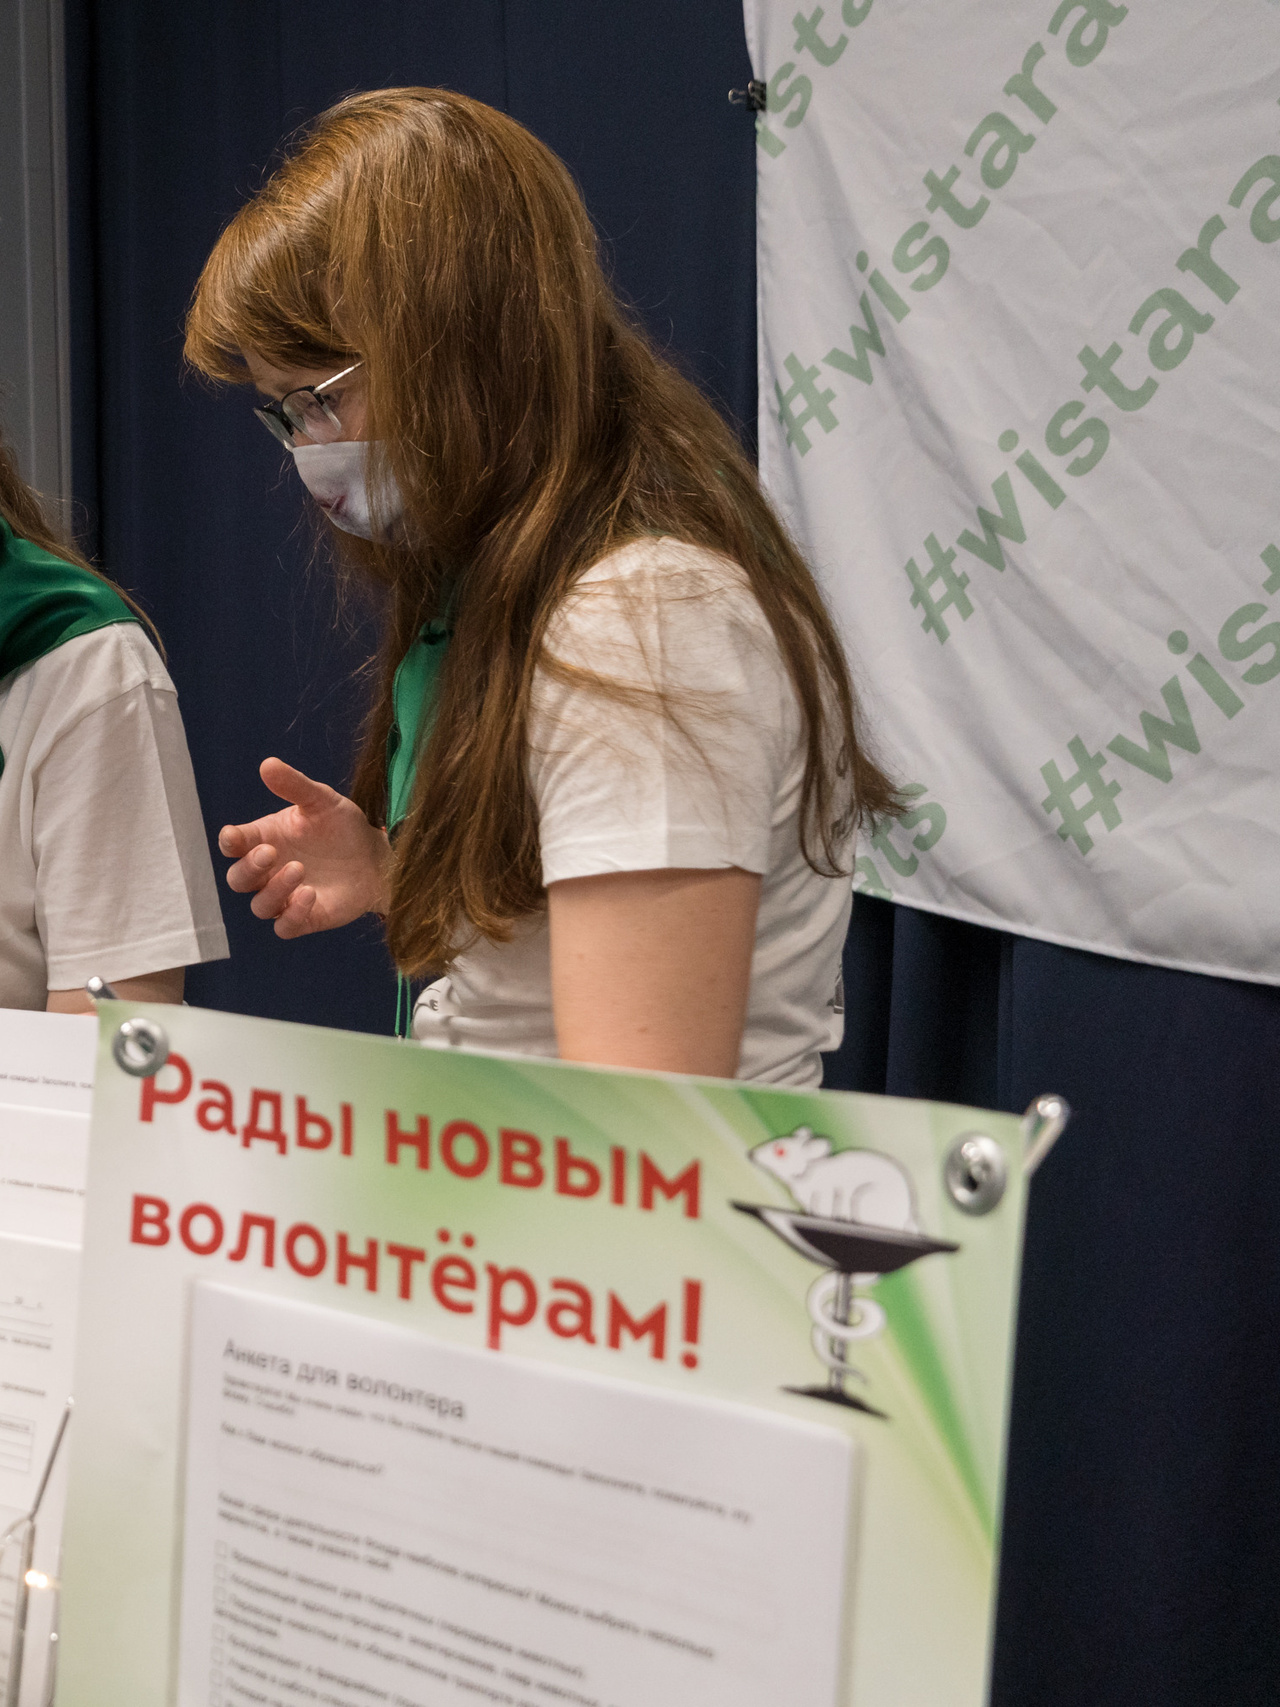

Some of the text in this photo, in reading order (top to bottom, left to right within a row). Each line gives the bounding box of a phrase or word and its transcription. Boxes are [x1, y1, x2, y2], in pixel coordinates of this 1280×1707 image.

[1039, 543, 1280, 857] #wis
[139, 1051, 702, 1220] Рады новым
[130, 1193, 702, 1370] волонтёрам!
[223, 1338, 466, 1421] Анкета для волонтера
